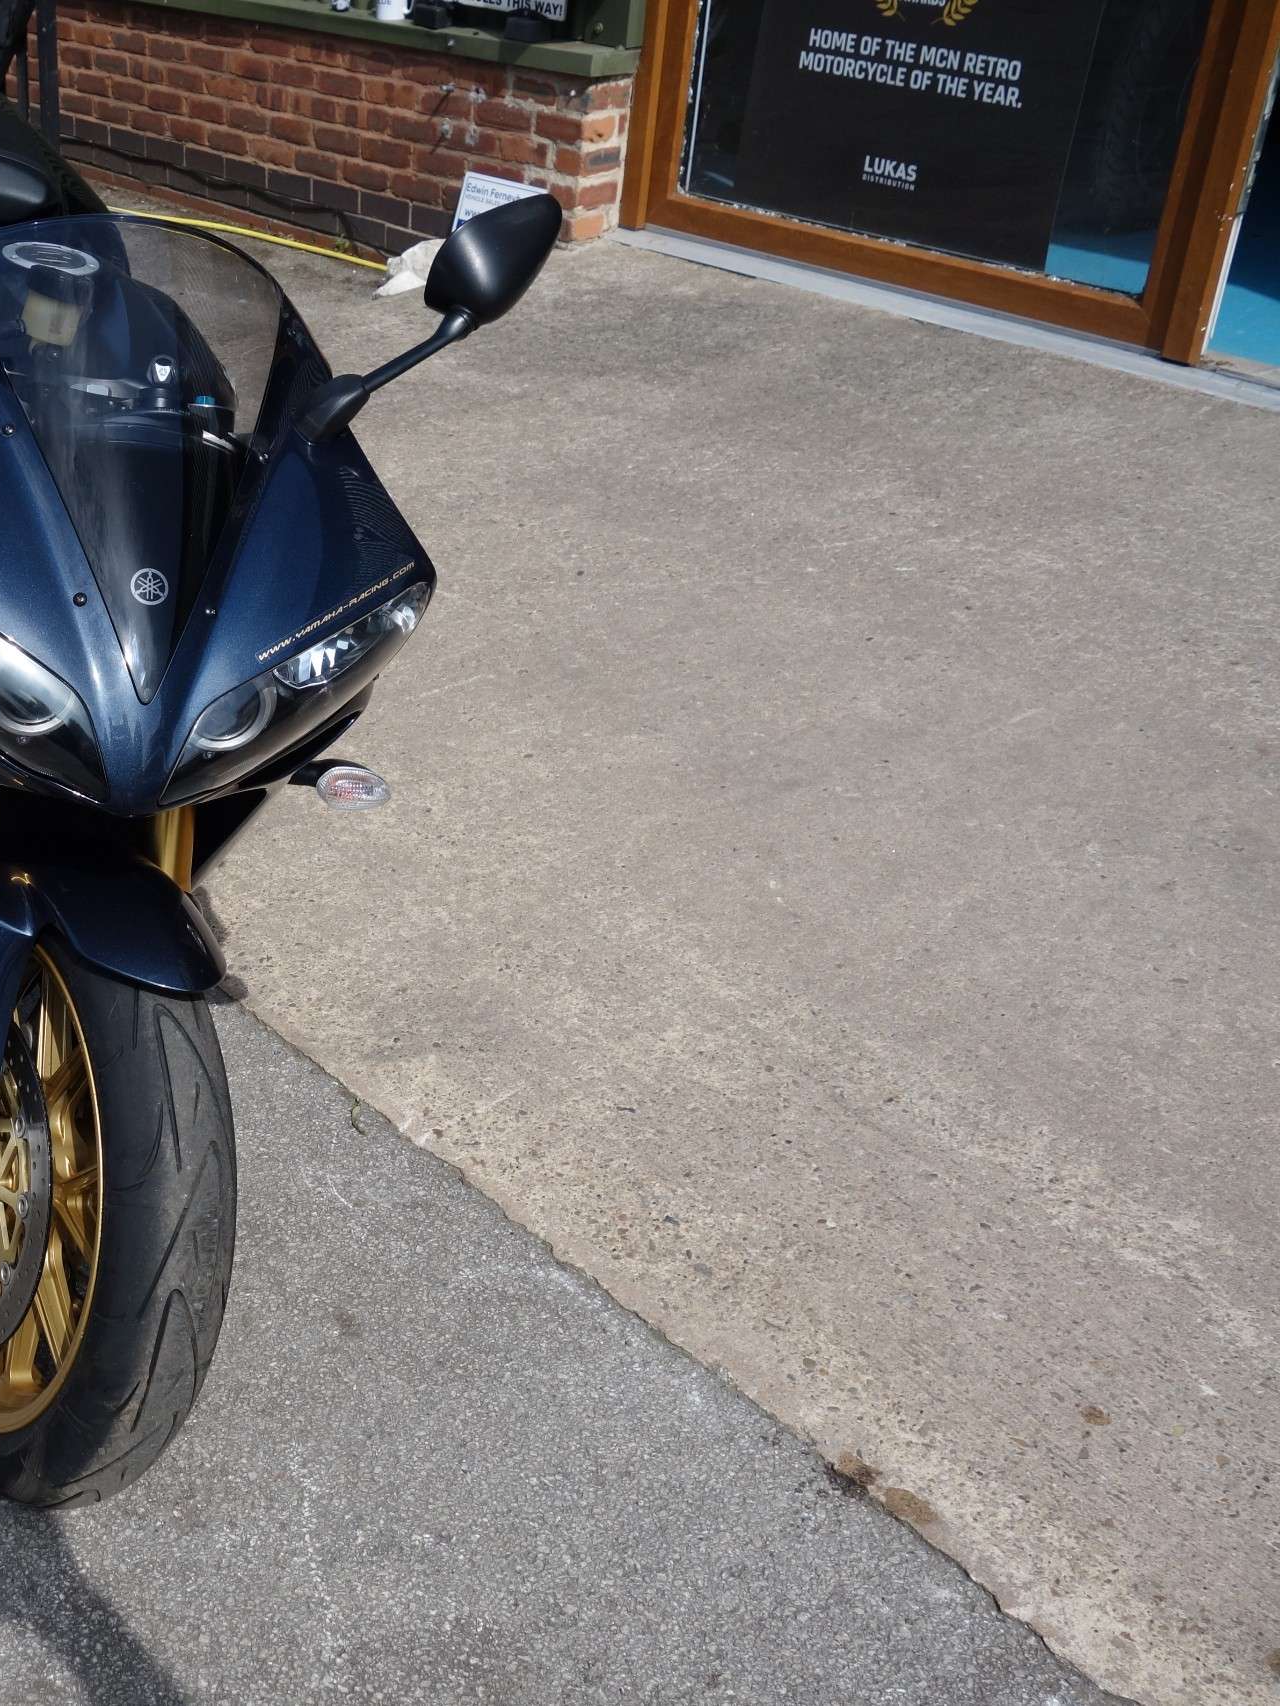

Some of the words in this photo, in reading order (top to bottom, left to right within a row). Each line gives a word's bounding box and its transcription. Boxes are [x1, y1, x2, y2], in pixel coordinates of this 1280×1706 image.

[809, 28, 857, 53] HOME
[860, 36, 882, 57] OF
[885, 39, 917, 63] THE
[919, 45, 961, 71] MCN
[963, 53, 1022, 81] RETRO
[798, 51, 907, 87] MOTORCYCLE
[910, 69, 933, 91] OF
[936, 74, 969, 98] THE
[972, 80, 1022, 108] YEAR.
[862, 173, 915, 191] DISTRIBUTION
[864, 154, 918, 182] LUKAS
[466, 183, 489, 195] Edwin
